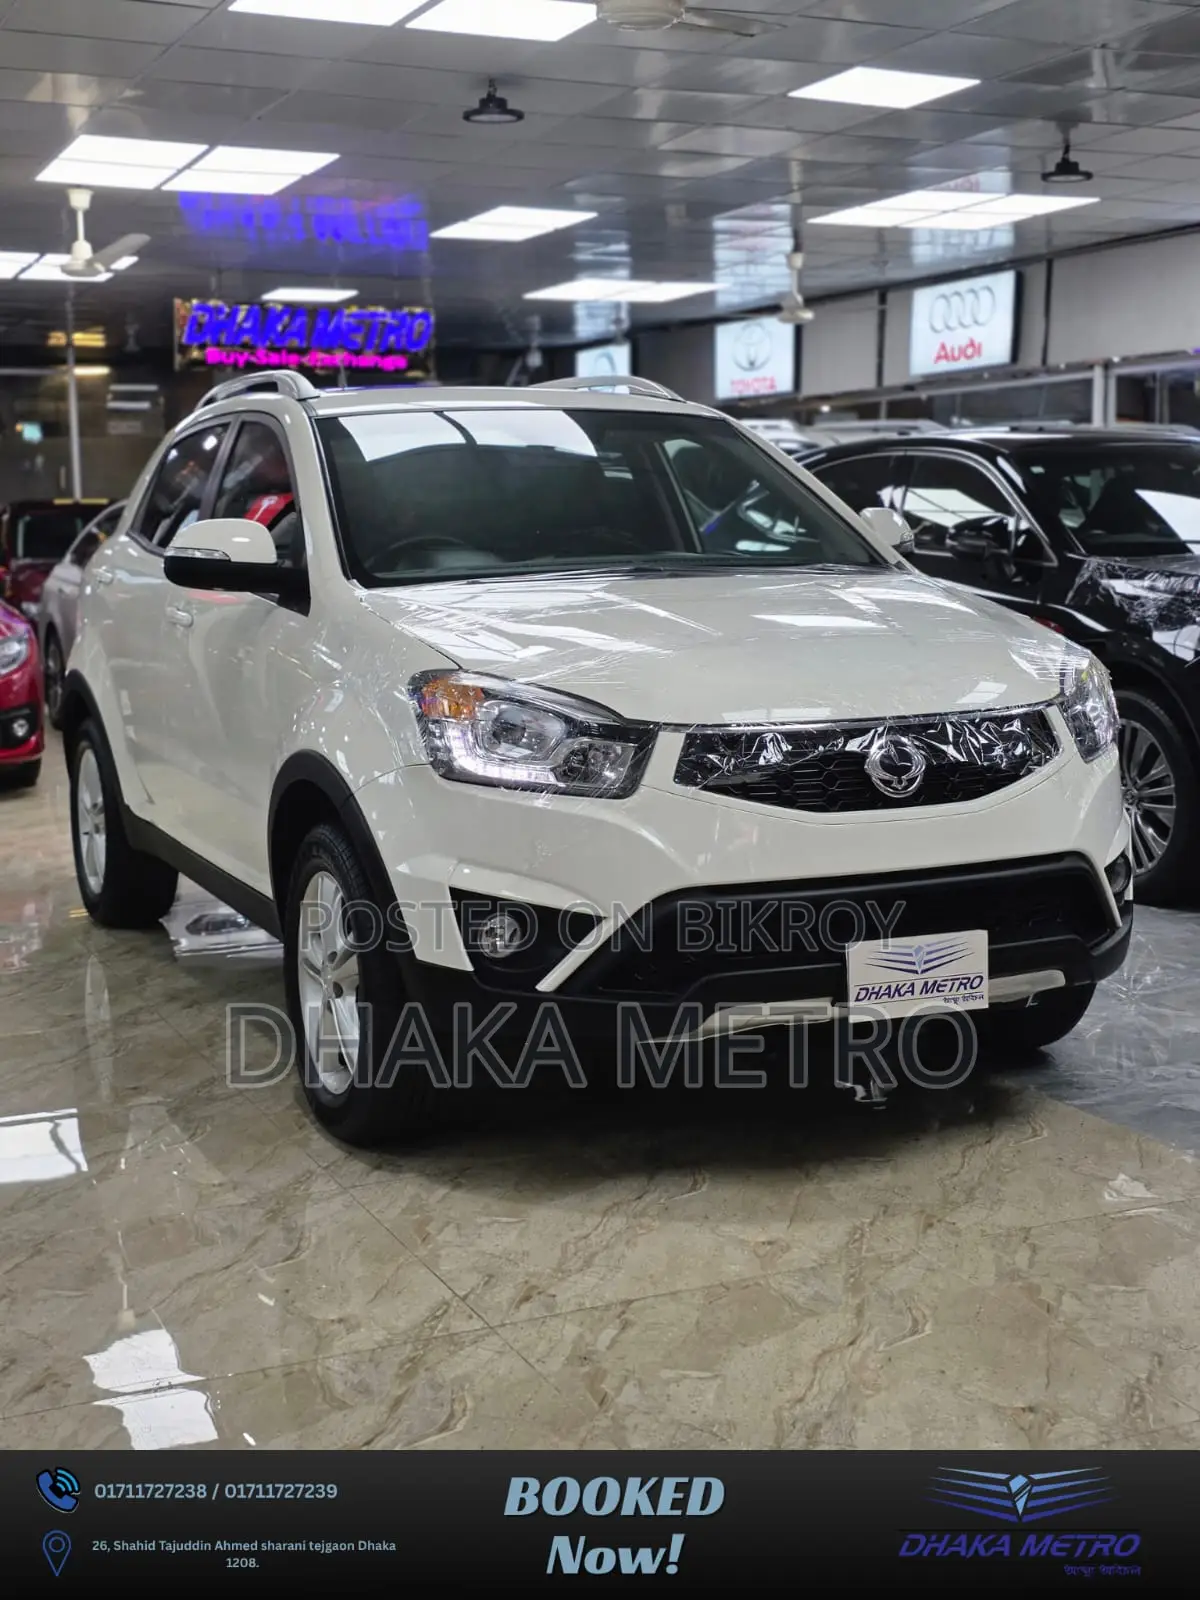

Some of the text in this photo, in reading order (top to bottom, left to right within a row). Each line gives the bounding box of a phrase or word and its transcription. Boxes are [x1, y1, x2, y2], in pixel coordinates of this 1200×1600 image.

[183, 303, 434, 351] DHAKA METRO
[933, 336, 983, 364] Audi
[730, 376, 777, 395] TOYOTA
[854, 974, 984, 1003] DHAKA METRO
